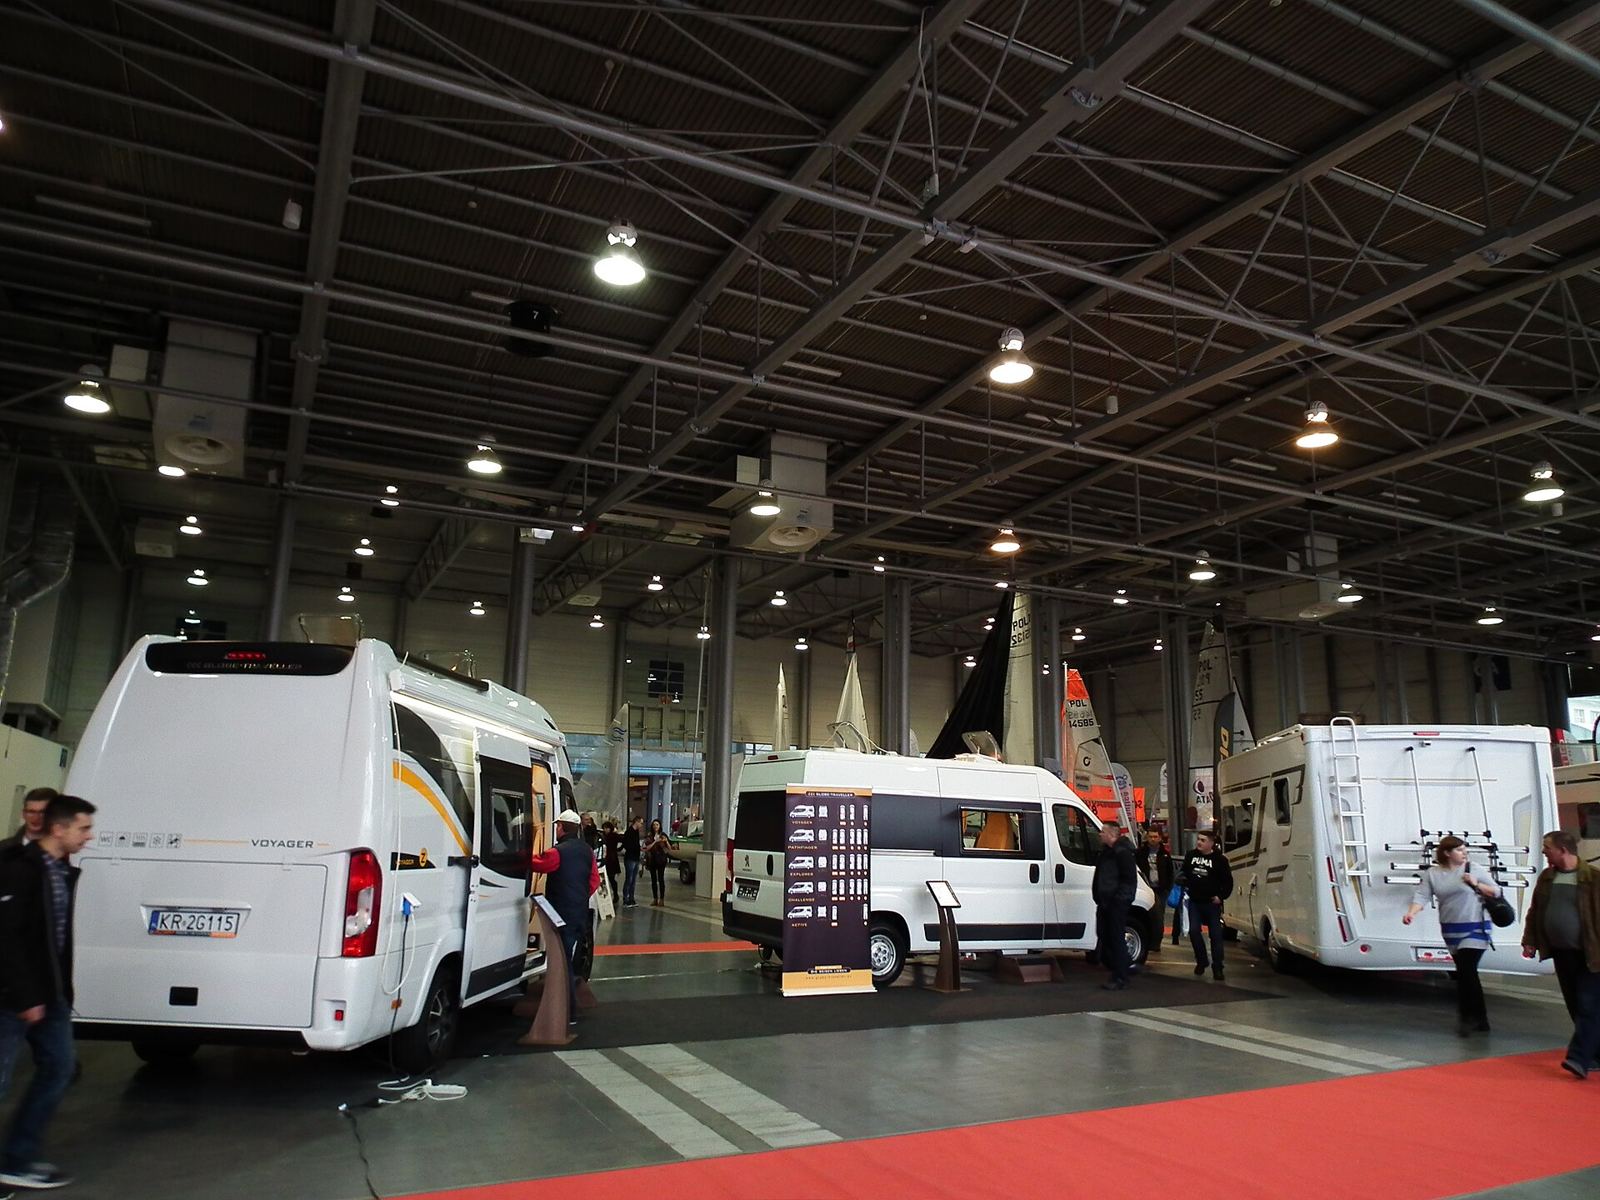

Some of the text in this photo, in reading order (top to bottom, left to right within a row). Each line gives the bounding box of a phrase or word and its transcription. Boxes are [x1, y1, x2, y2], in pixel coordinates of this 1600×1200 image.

[532, 310, 539, 320] 7
[1069, 699, 1087, 708] POL
[1068, 718, 1094, 728] 14585
[251, 839, 314, 849] VOYAGER
[1191, 857, 1212, 868] PUMA
[159, 913, 183, 930] KR
[186, 914, 235, 932] 2G115
